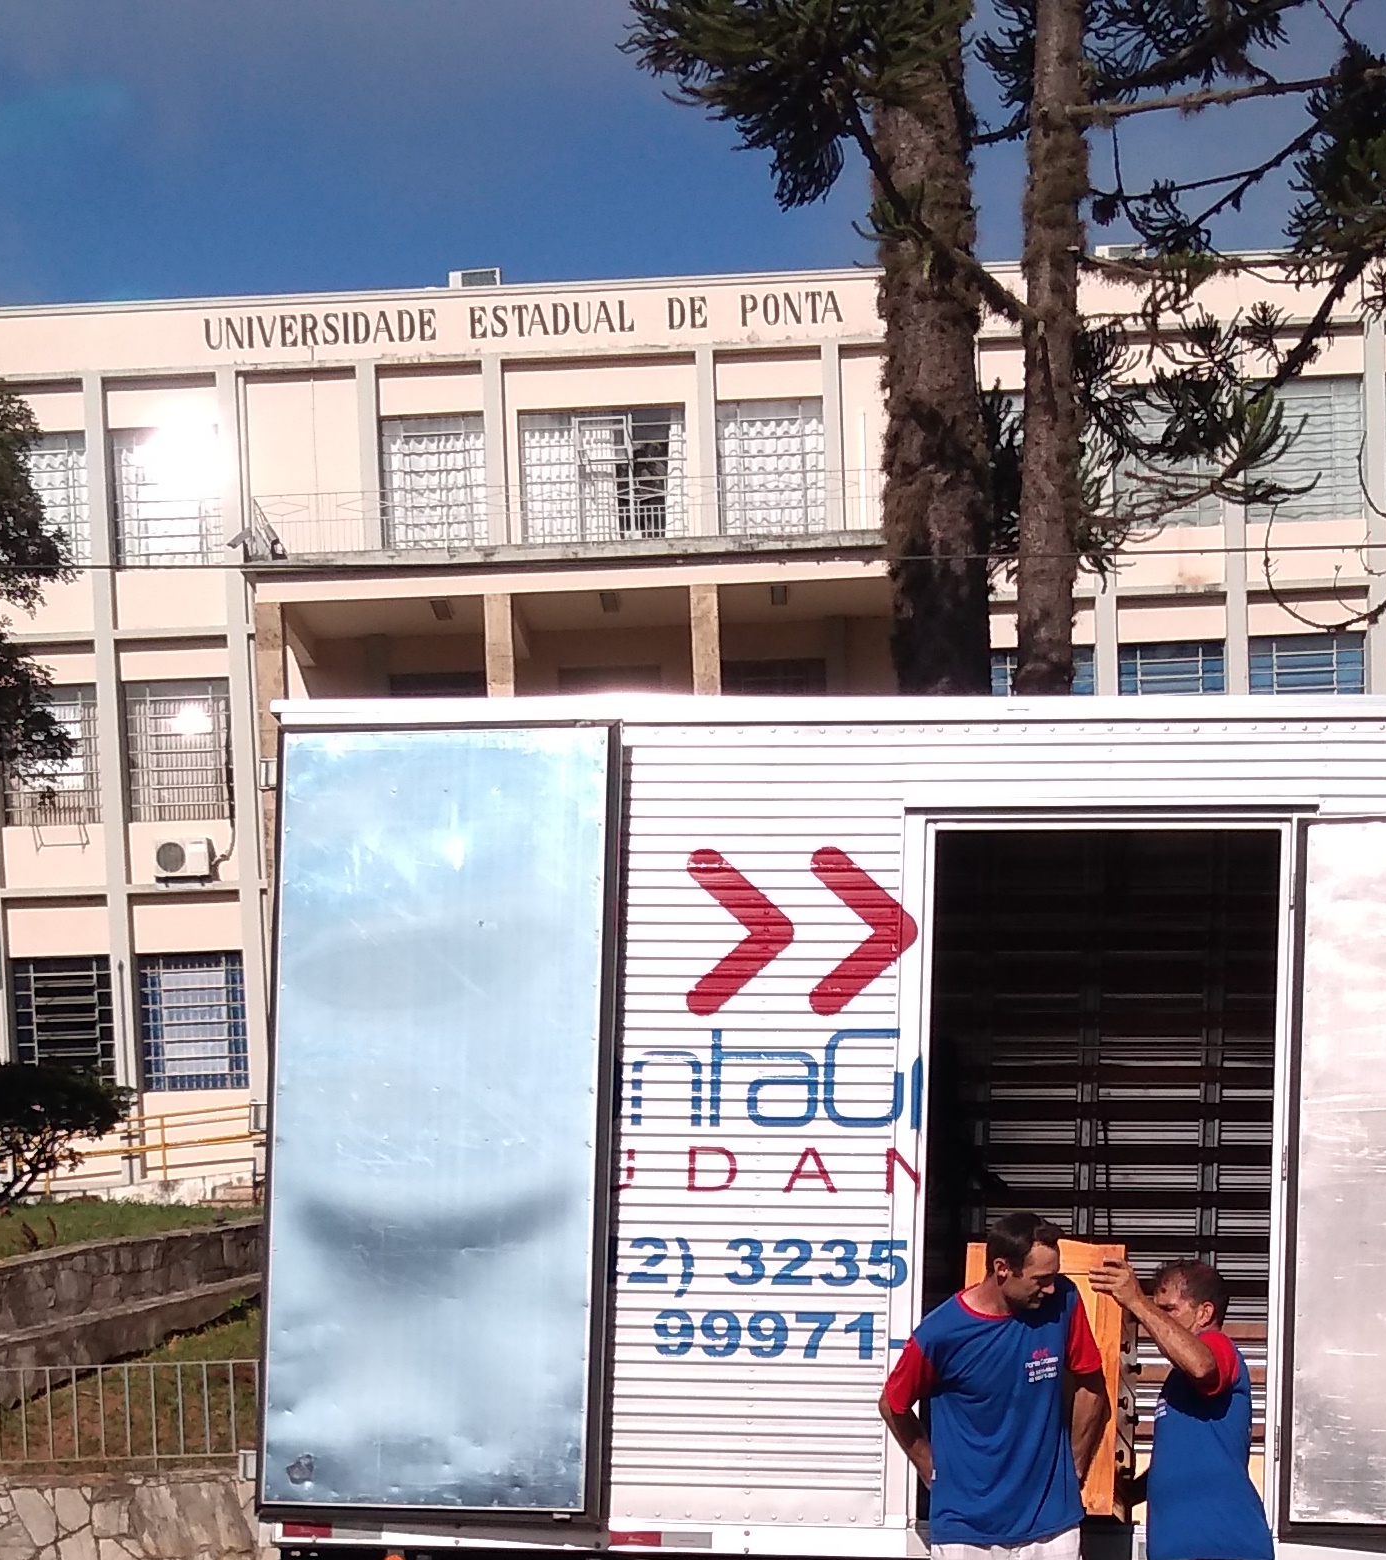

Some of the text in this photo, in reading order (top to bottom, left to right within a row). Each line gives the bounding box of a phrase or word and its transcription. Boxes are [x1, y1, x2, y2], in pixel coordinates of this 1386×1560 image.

[203, 289, 845, 350] UNIVERSIDADE ESTADUAL DE PONTA
[608, 1236, 908, 1297] 2) 3235
